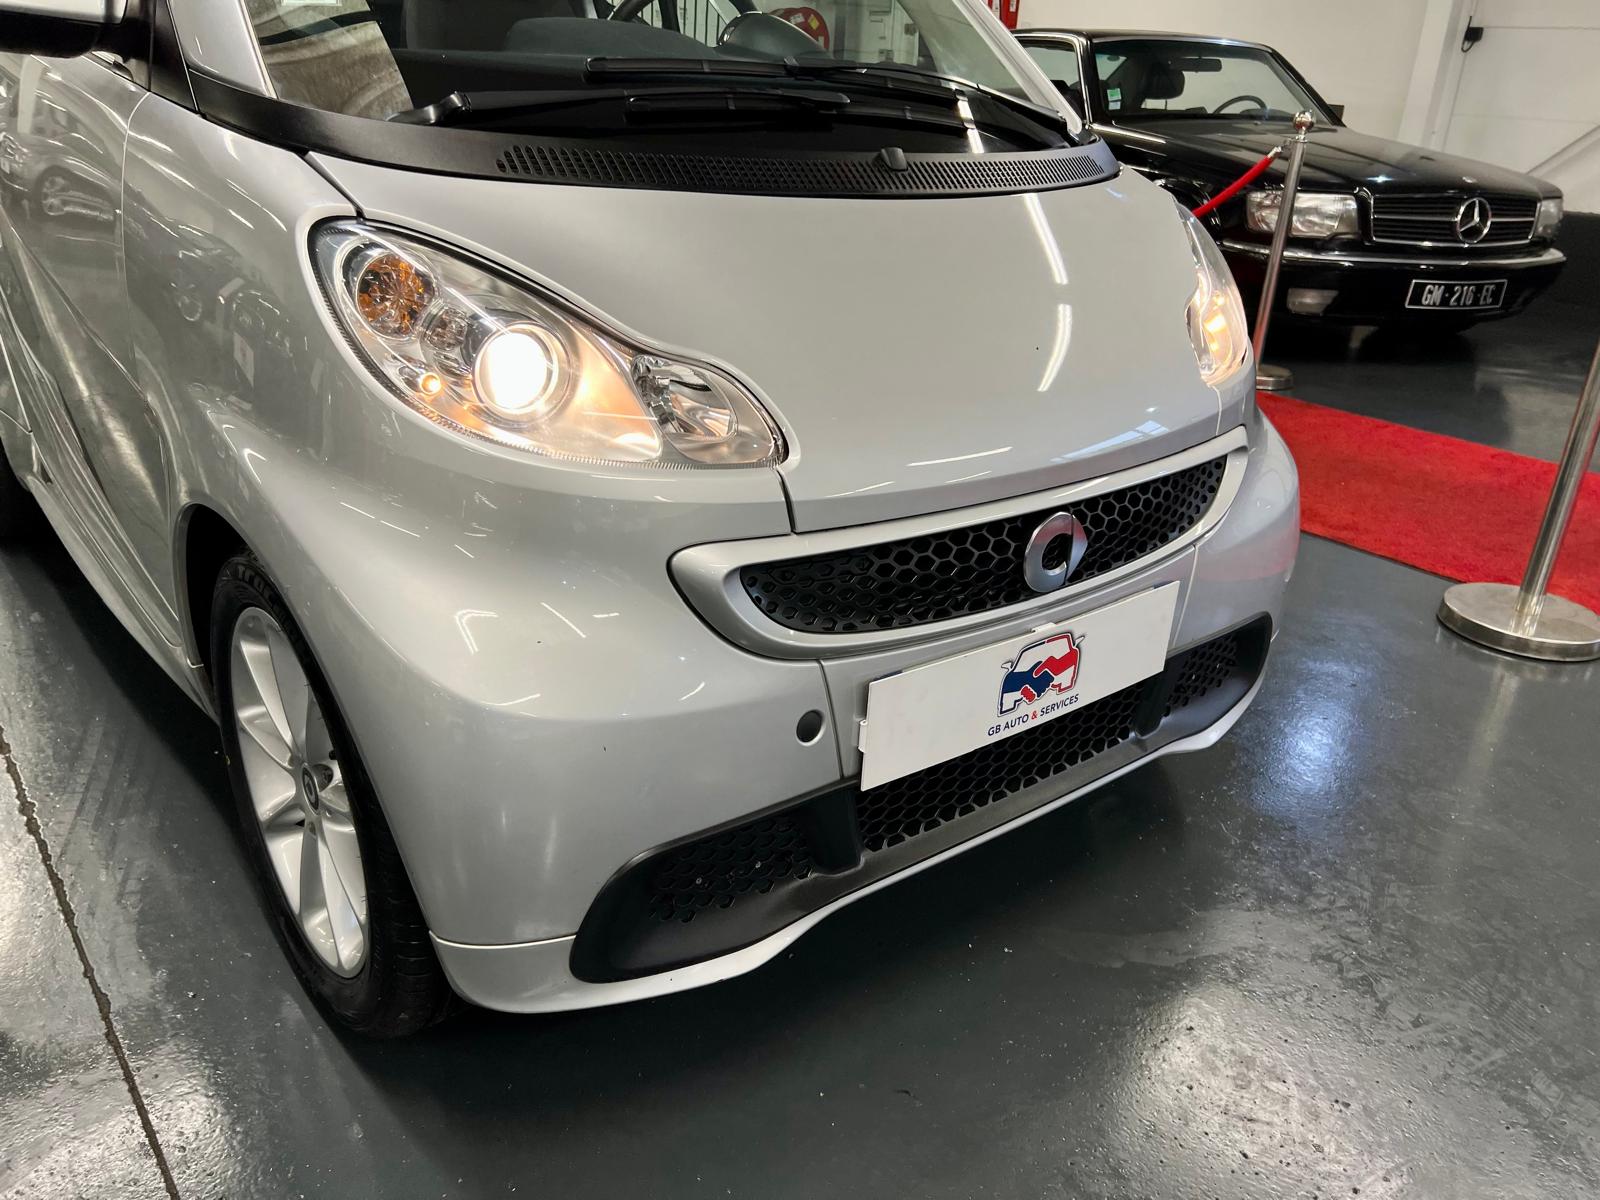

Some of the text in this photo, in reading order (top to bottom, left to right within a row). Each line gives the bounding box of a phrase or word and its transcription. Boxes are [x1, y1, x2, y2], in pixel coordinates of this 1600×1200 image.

[987, 693, 1079, 736] GB AUTO & SERVICES
